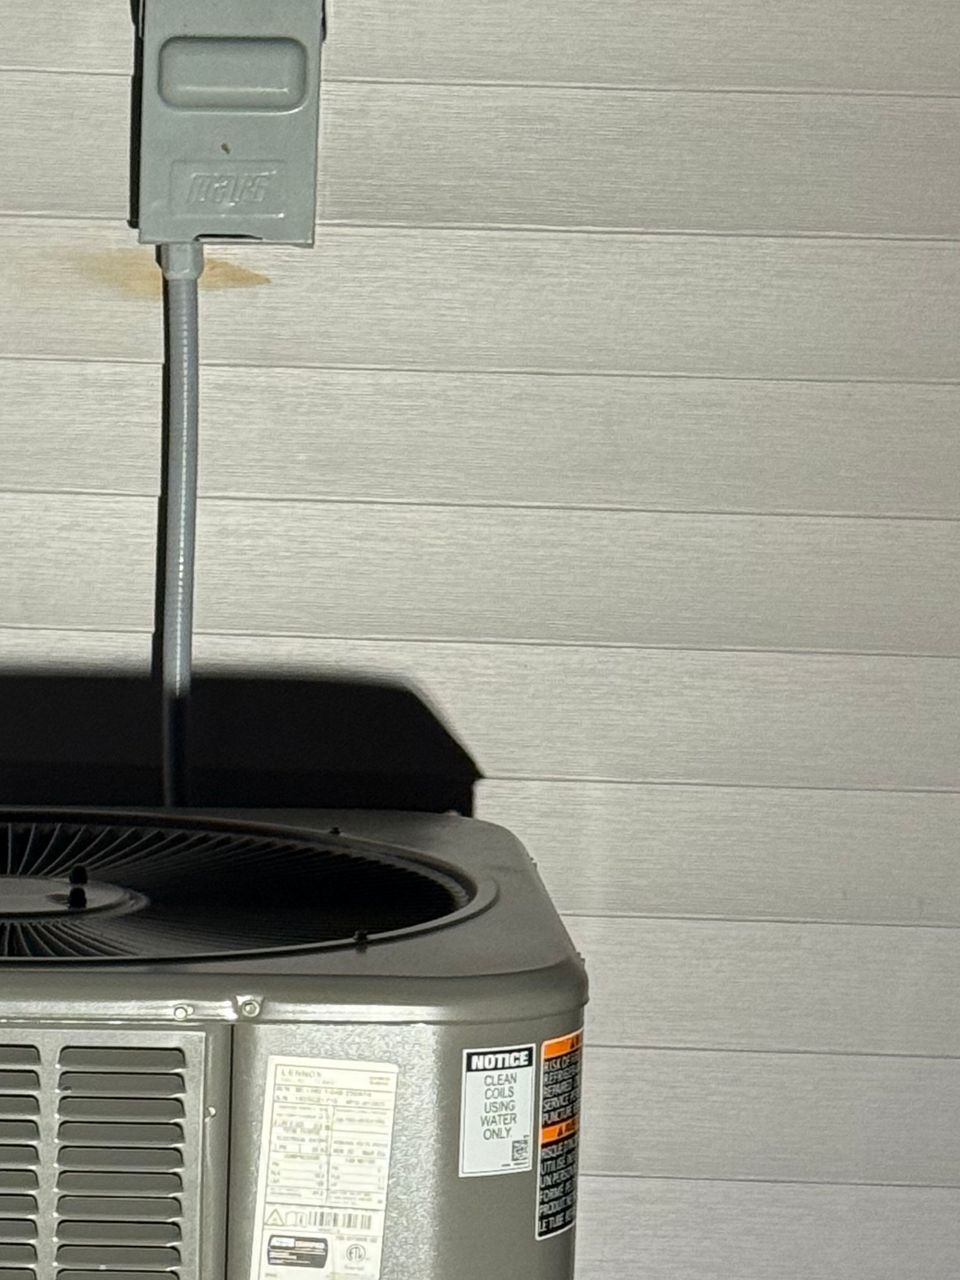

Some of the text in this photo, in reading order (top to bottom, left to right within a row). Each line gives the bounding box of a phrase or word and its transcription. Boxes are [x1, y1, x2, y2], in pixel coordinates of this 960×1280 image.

[471, 1051, 529, 1071] NOTICE
[484, 1072, 517, 1086] CLEAN
[484, 1086, 515, 1100] COILS
[483, 1100, 516, 1114] USING
[480, 1113, 517, 1128] WATER
